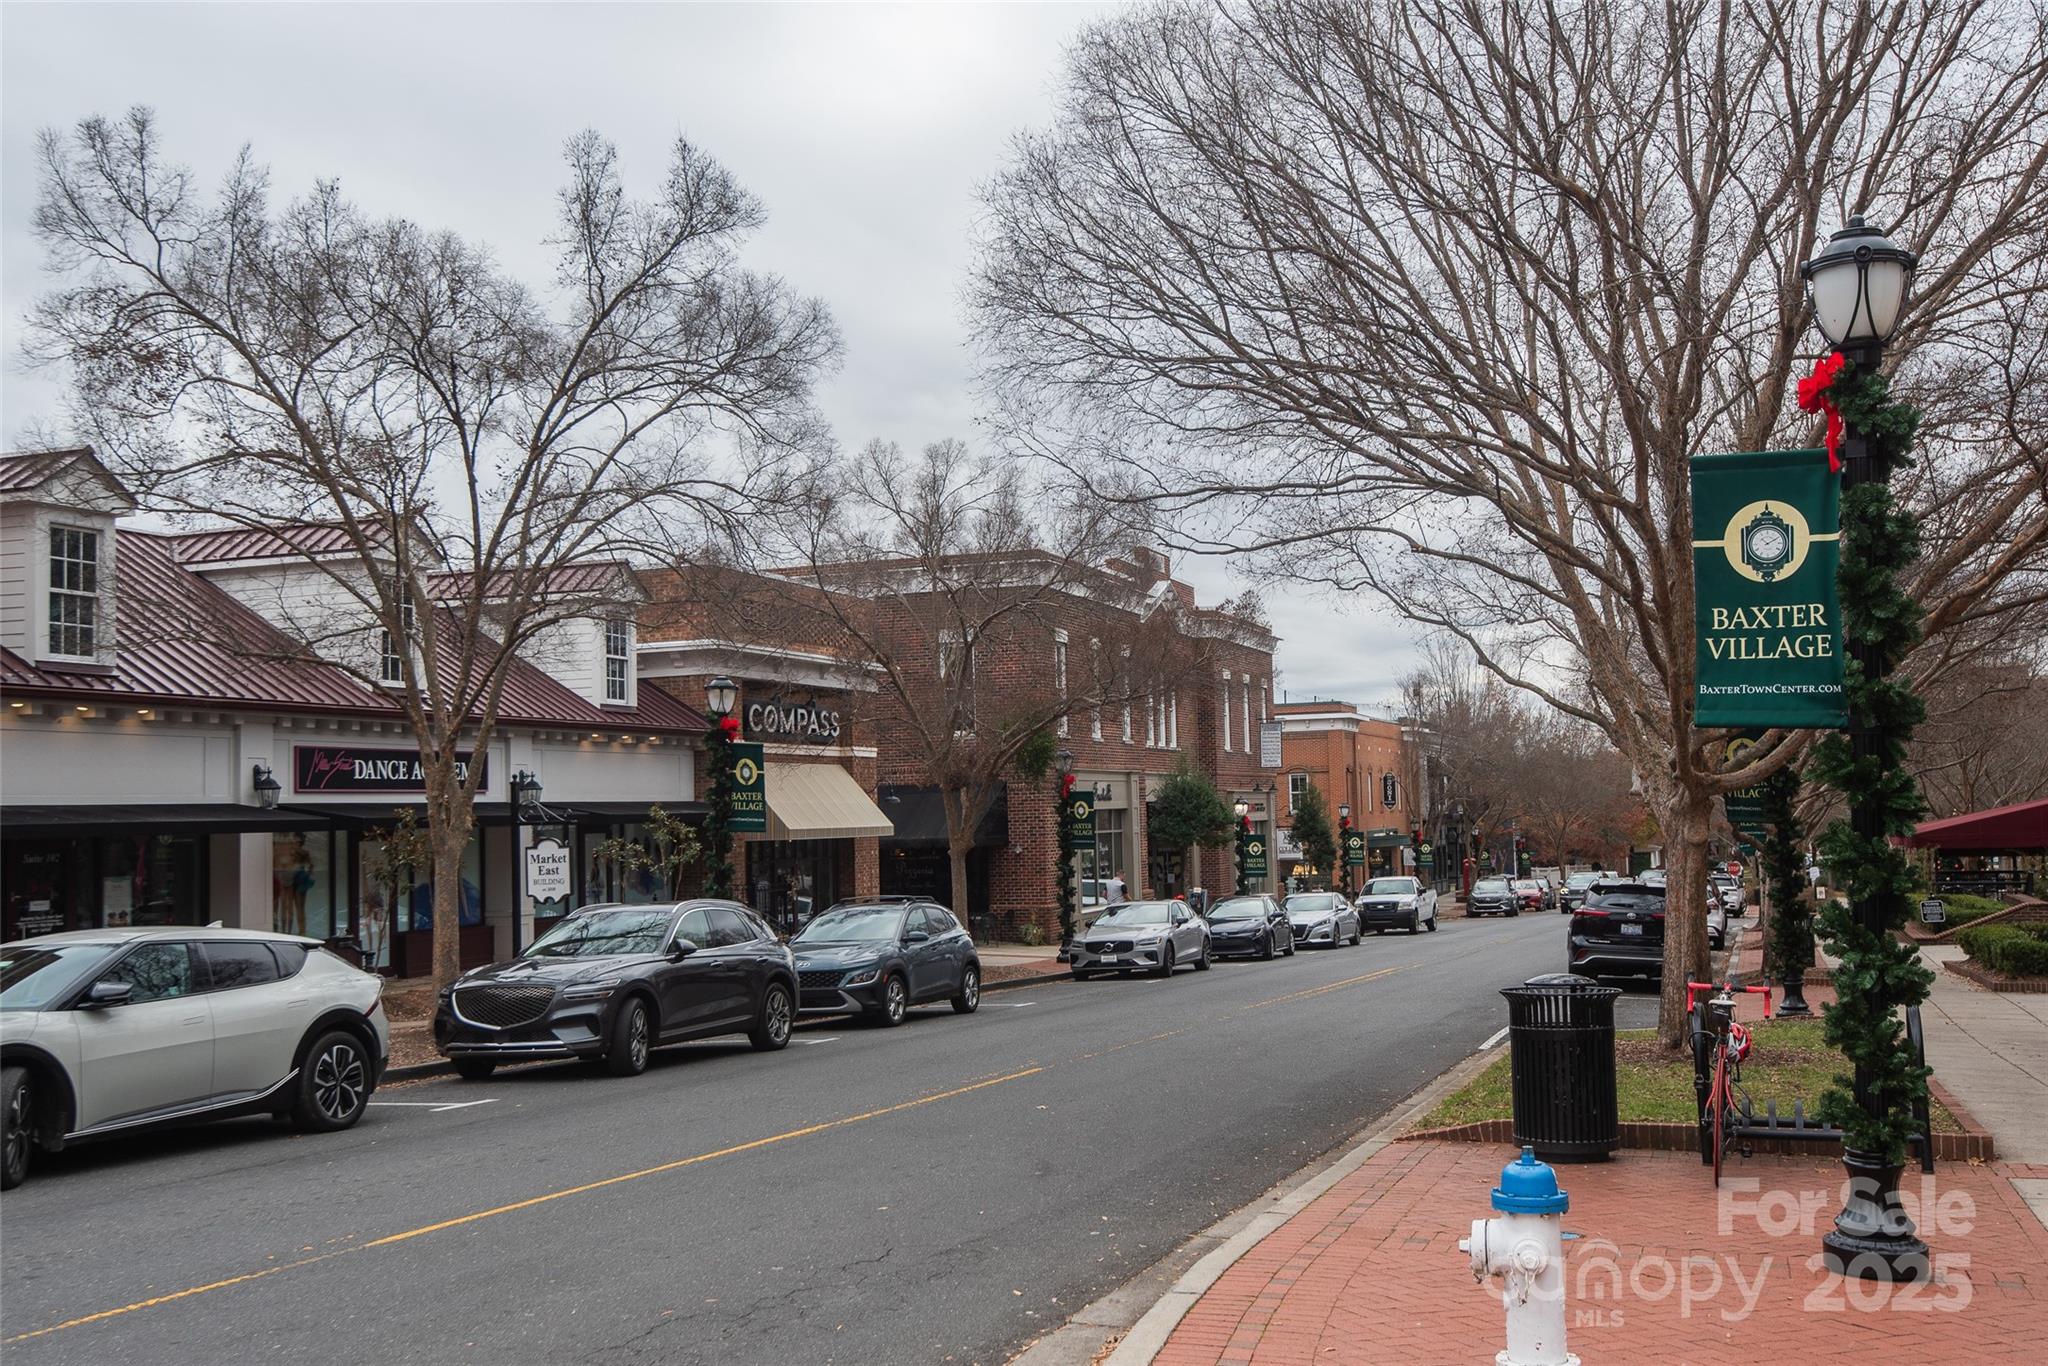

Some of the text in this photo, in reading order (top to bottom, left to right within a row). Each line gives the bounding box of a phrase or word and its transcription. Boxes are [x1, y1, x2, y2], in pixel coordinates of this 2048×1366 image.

[1712, 603, 1828, 630] BAXTER
[1705, 634, 1833, 660] VILLAGE
[1699, 683, 1842, 695] BAXTERTOWNCENTER.COM
[748, 704, 840, 737] COMPASS
[353, 759, 409, 780] DANCE
[530, 854, 567, 865] Market
[538, 866, 560, 876] East
